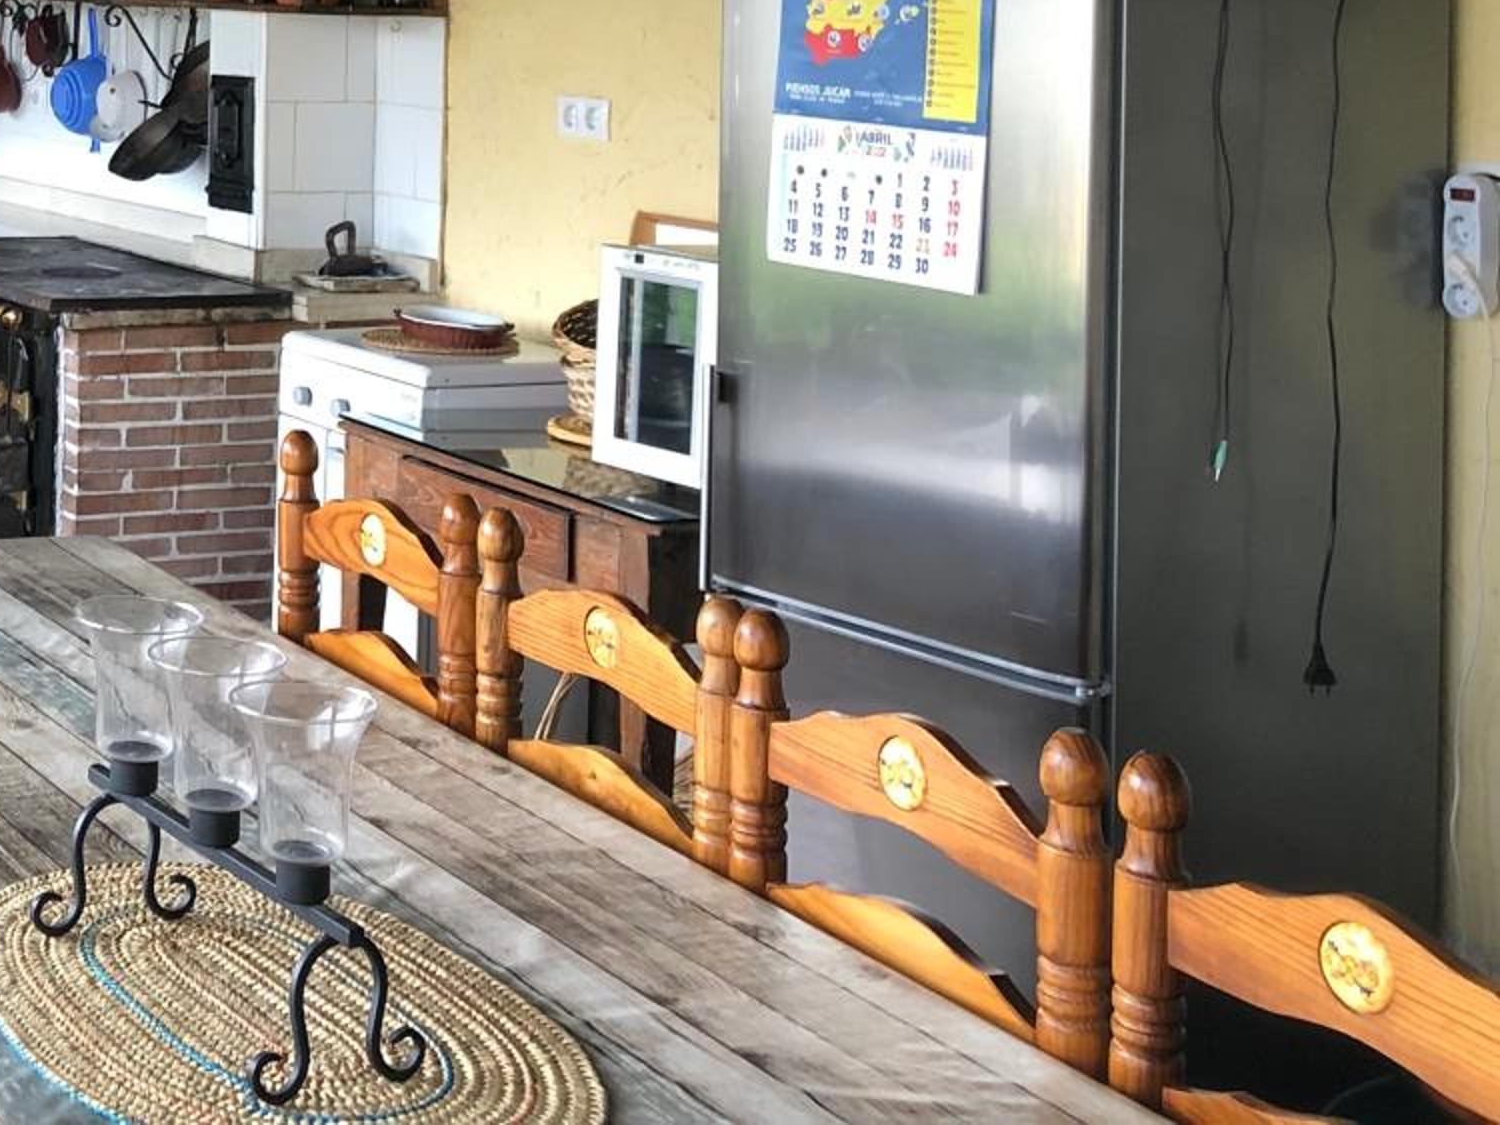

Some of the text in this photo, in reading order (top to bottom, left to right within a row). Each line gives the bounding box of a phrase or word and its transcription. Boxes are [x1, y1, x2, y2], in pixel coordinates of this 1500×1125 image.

[790, 179, 797, 194] 4
[815, 183, 821, 198] 5
[841, 186, 848, 202] 6
[868, 190, 875, 204] 7
[922, 197, 928, 212] 9
[948, 200, 960, 216] 10
[897, 173, 958, 196] 1 2 3
[788, 199, 958, 237] 11 12 13 14 15 16 17
[783, 238, 796, 252] 25
[810, 241, 822, 256] 26
[835, 245, 847, 261] 27
[888, 254, 901, 270] 29
[915, 258, 928, 274] 30
[836, 226, 848, 241] 20
[862, 229, 875, 245] 21
[889, 233, 903, 249] 22
[943, 242, 957, 257] 24
